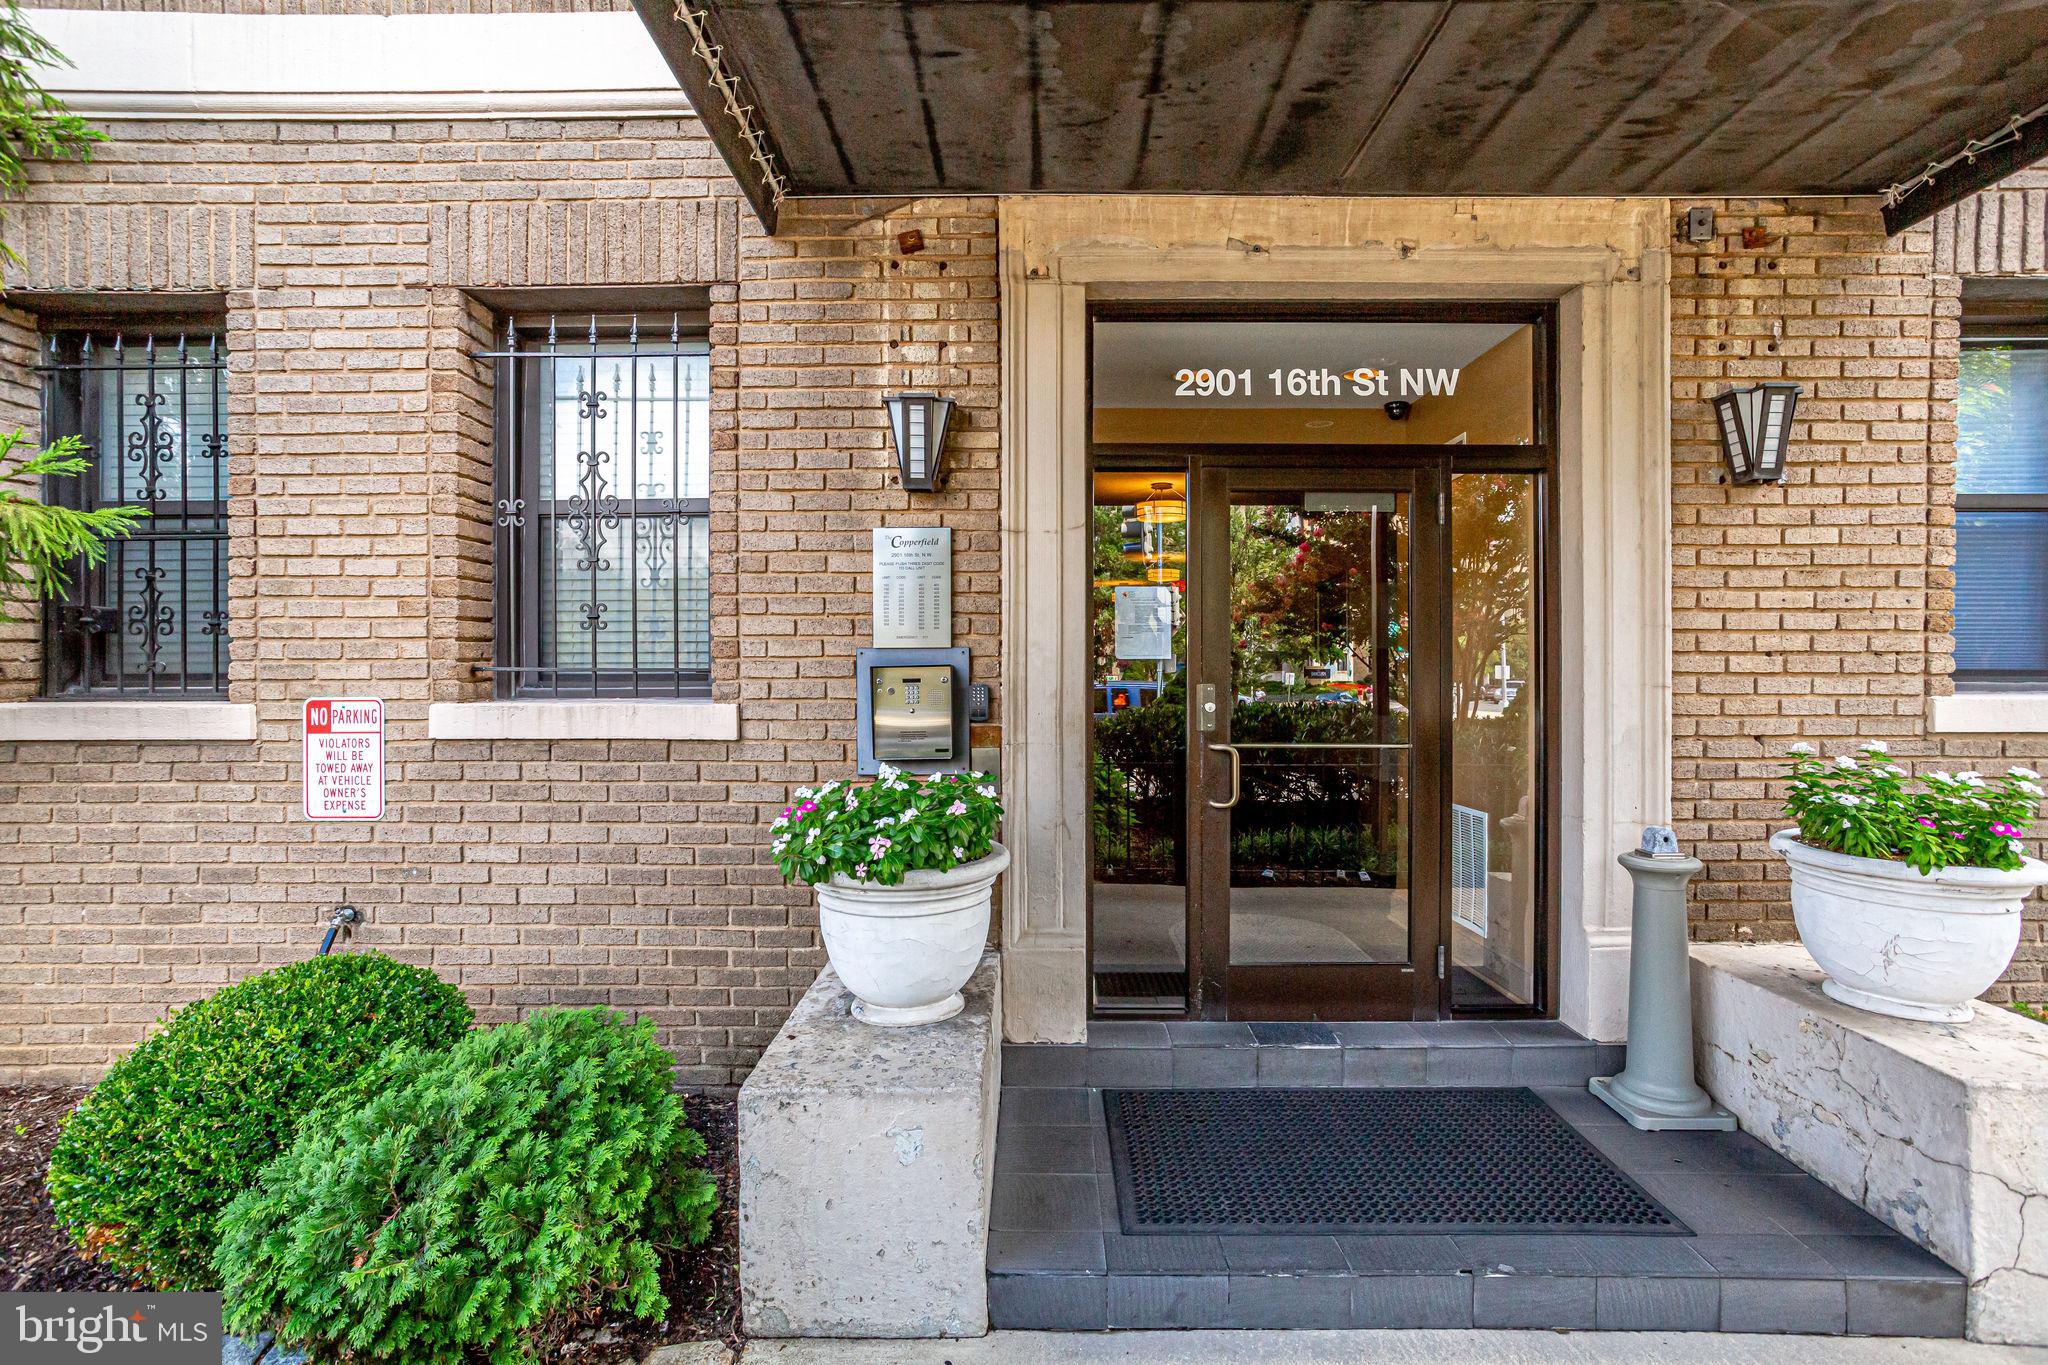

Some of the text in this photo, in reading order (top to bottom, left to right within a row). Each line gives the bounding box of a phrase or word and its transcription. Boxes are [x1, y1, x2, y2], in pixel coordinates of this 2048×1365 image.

[1174, 368, 1461, 397] 2901 16th St NW
[891, 535, 940, 548] Copperfield
[310, 707, 377, 726] NO PARKING
[319, 738, 370, 749] VIOLATORS
[325, 750, 364, 761] WILL BE
[316, 763, 374, 773] TOWED AWAY
[318, 775, 372, 786] AT VEHICLE
[323, 788, 367, 798] OWNER'S
[324, 800, 366, 811] EXPENSE
